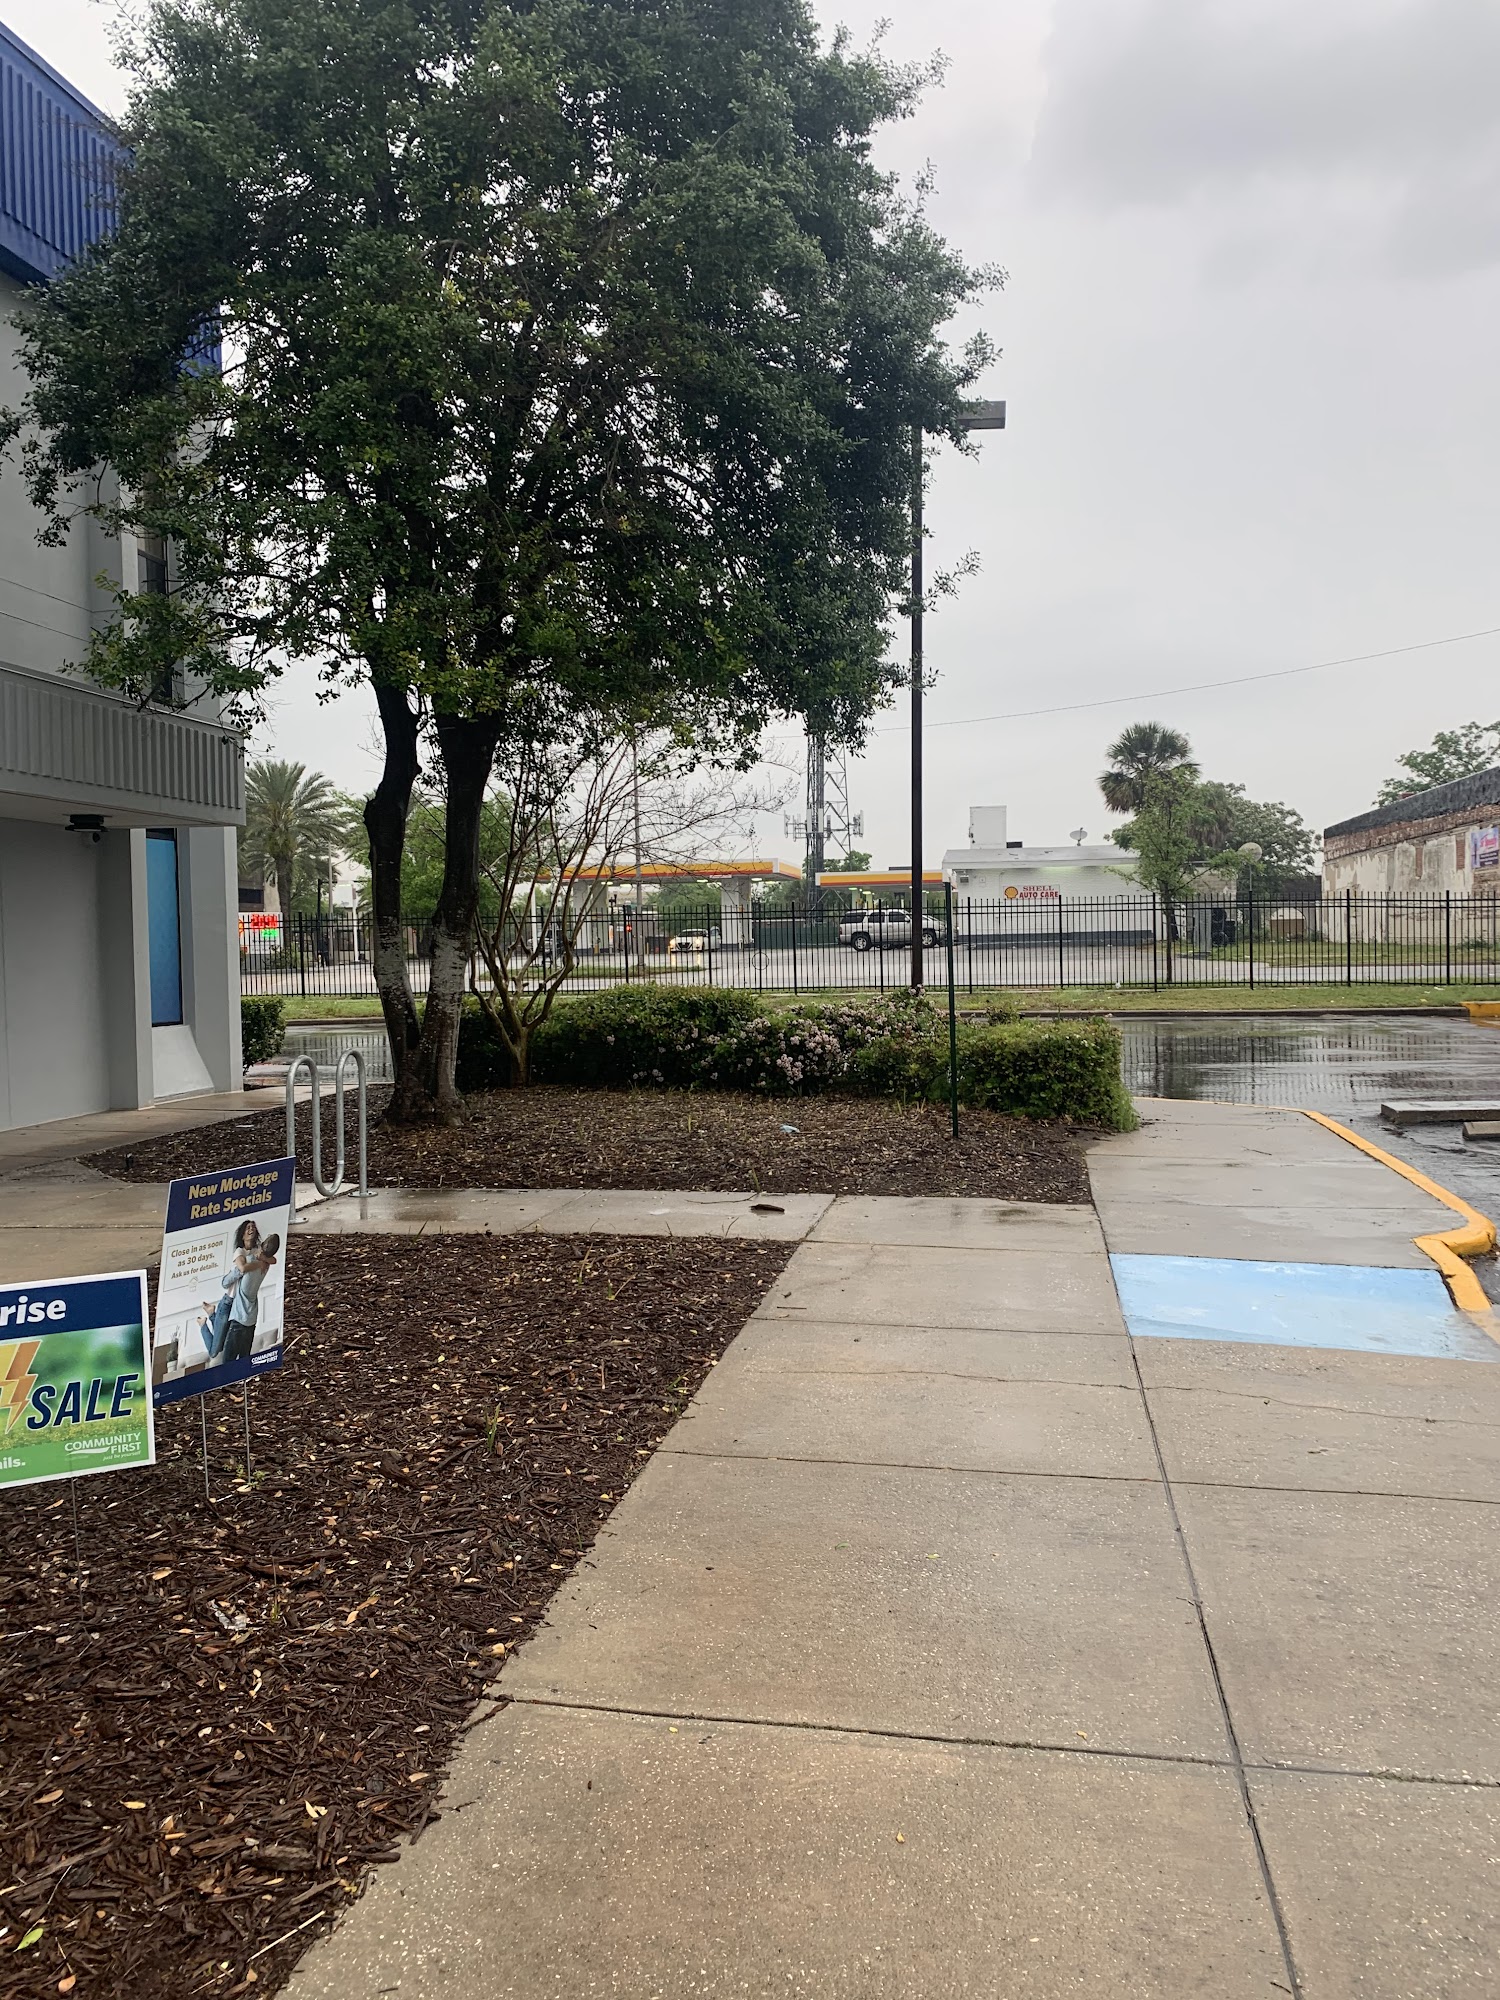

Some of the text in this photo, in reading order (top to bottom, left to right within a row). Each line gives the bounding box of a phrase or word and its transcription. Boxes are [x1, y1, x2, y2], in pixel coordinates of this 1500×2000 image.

[188, 1171, 278, 1200] New Mortgage
[190, 1189, 272, 1219] Rate Specials
[171, 1247, 190, 1258] Close
[191, 1245, 198, 1253] in
[207, 1240, 223, 1249] soon
[187, 1256, 196, 1265] 30
[198, 1253, 215, 1262] days.
[171, 1271, 182, 1279] Ask
[200, 1262, 219, 1271] details.
[0, 1295, 67, 1327] rise
[251, 1350, 278, 1363] COMMUNITY
[27, 1373, 140, 1430] SALE
[64, 1432, 141, 1452] COMMUNITY
[111, 1442, 142, 1454] FIRST
[121, 1450, 141, 1458] yourself
